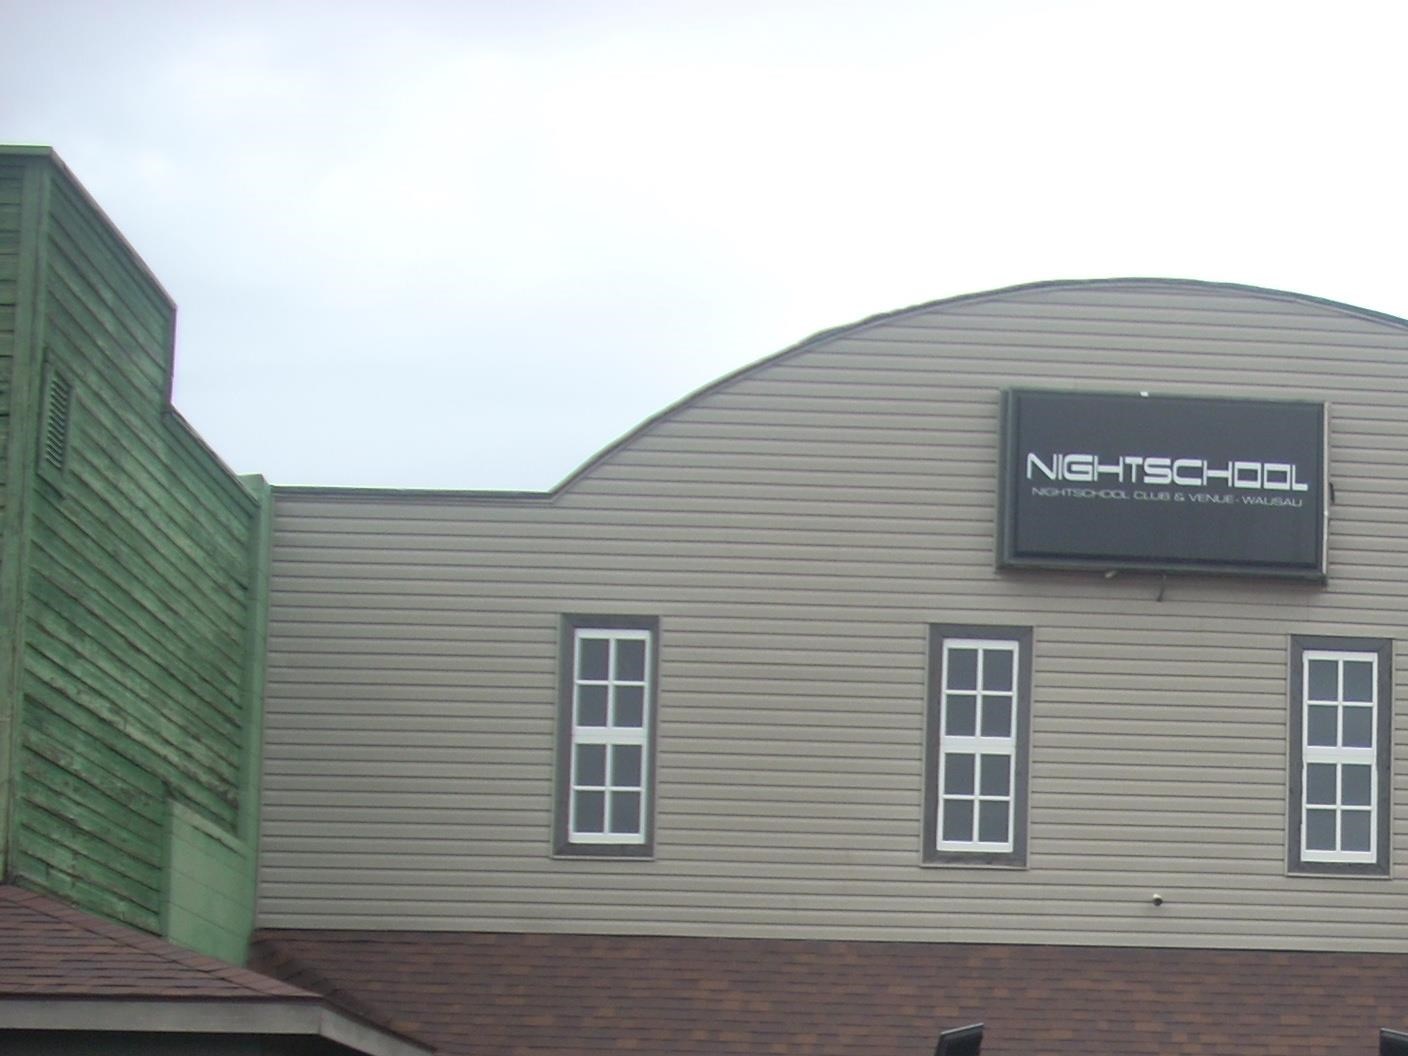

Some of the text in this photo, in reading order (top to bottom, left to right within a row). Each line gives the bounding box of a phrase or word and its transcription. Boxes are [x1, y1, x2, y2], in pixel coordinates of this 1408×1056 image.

[1026, 452, 1309, 492] NIGHTSCHOOL
[1031, 487, 1128, 500] NIGHTSCHOOL
[1134, 491, 1171, 501] CLUB
[1188, 493, 1234, 505] VENUE
[1242, 496, 1303, 507] WAUSAU
